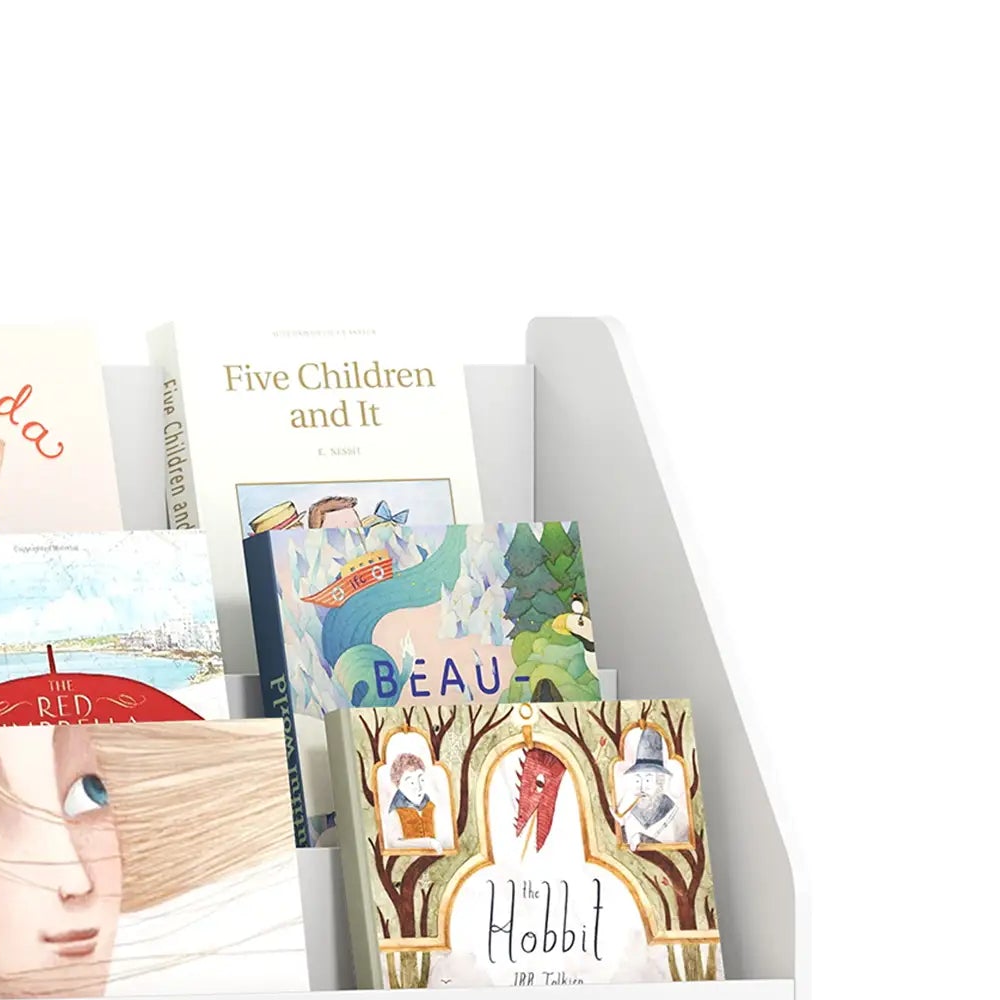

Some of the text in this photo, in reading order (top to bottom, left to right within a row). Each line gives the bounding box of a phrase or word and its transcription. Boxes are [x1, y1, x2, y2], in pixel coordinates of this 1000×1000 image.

[223, 361, 436, 392] Five Children
[290, 399, 383, 429] and It
[163, 421, 188, 497] Children
[48, 680, 74, 692] THE
[374, 655, 531, 698] BEAU-
[38, 693, 93, 718] RED
[522, 880, 540, 899] the
[486, 878, 603, 963] Hobbit
